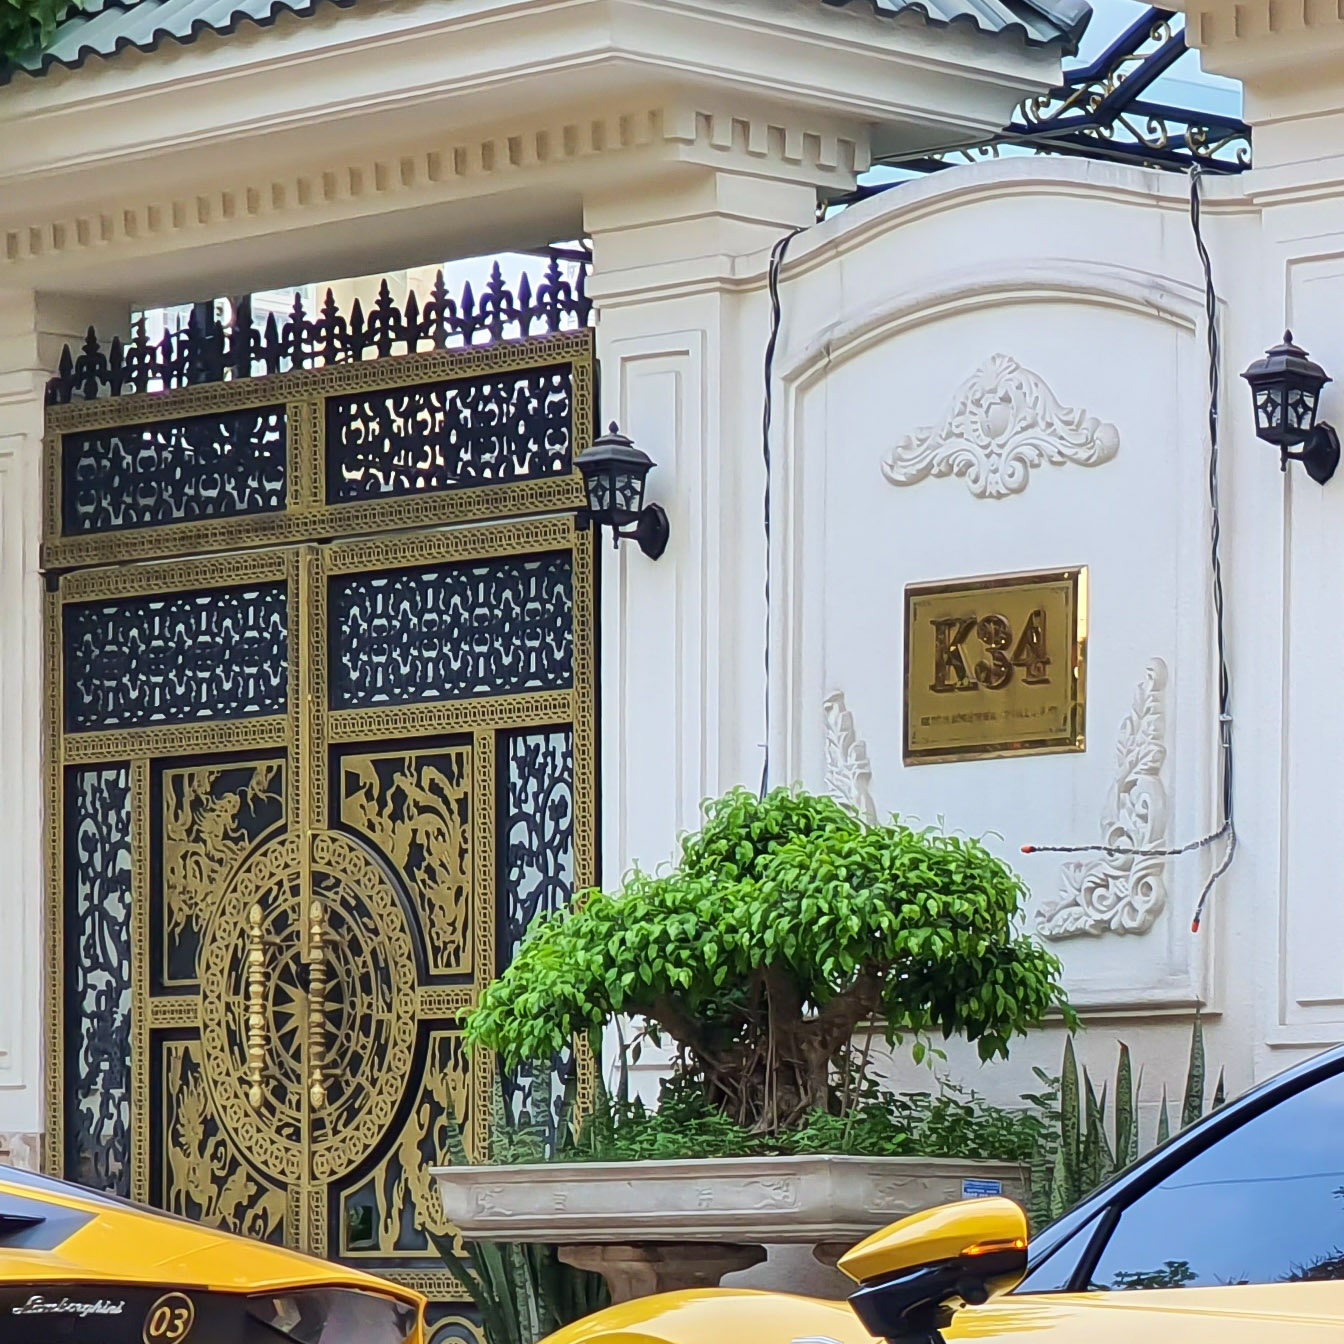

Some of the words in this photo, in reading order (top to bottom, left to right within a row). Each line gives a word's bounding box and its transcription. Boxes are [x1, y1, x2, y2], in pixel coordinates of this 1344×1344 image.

[928, 609, 1052, 693] K34
[12, 1295, 125, 1317] Lamborghini
[150, 1306, 189, 1338] 03
